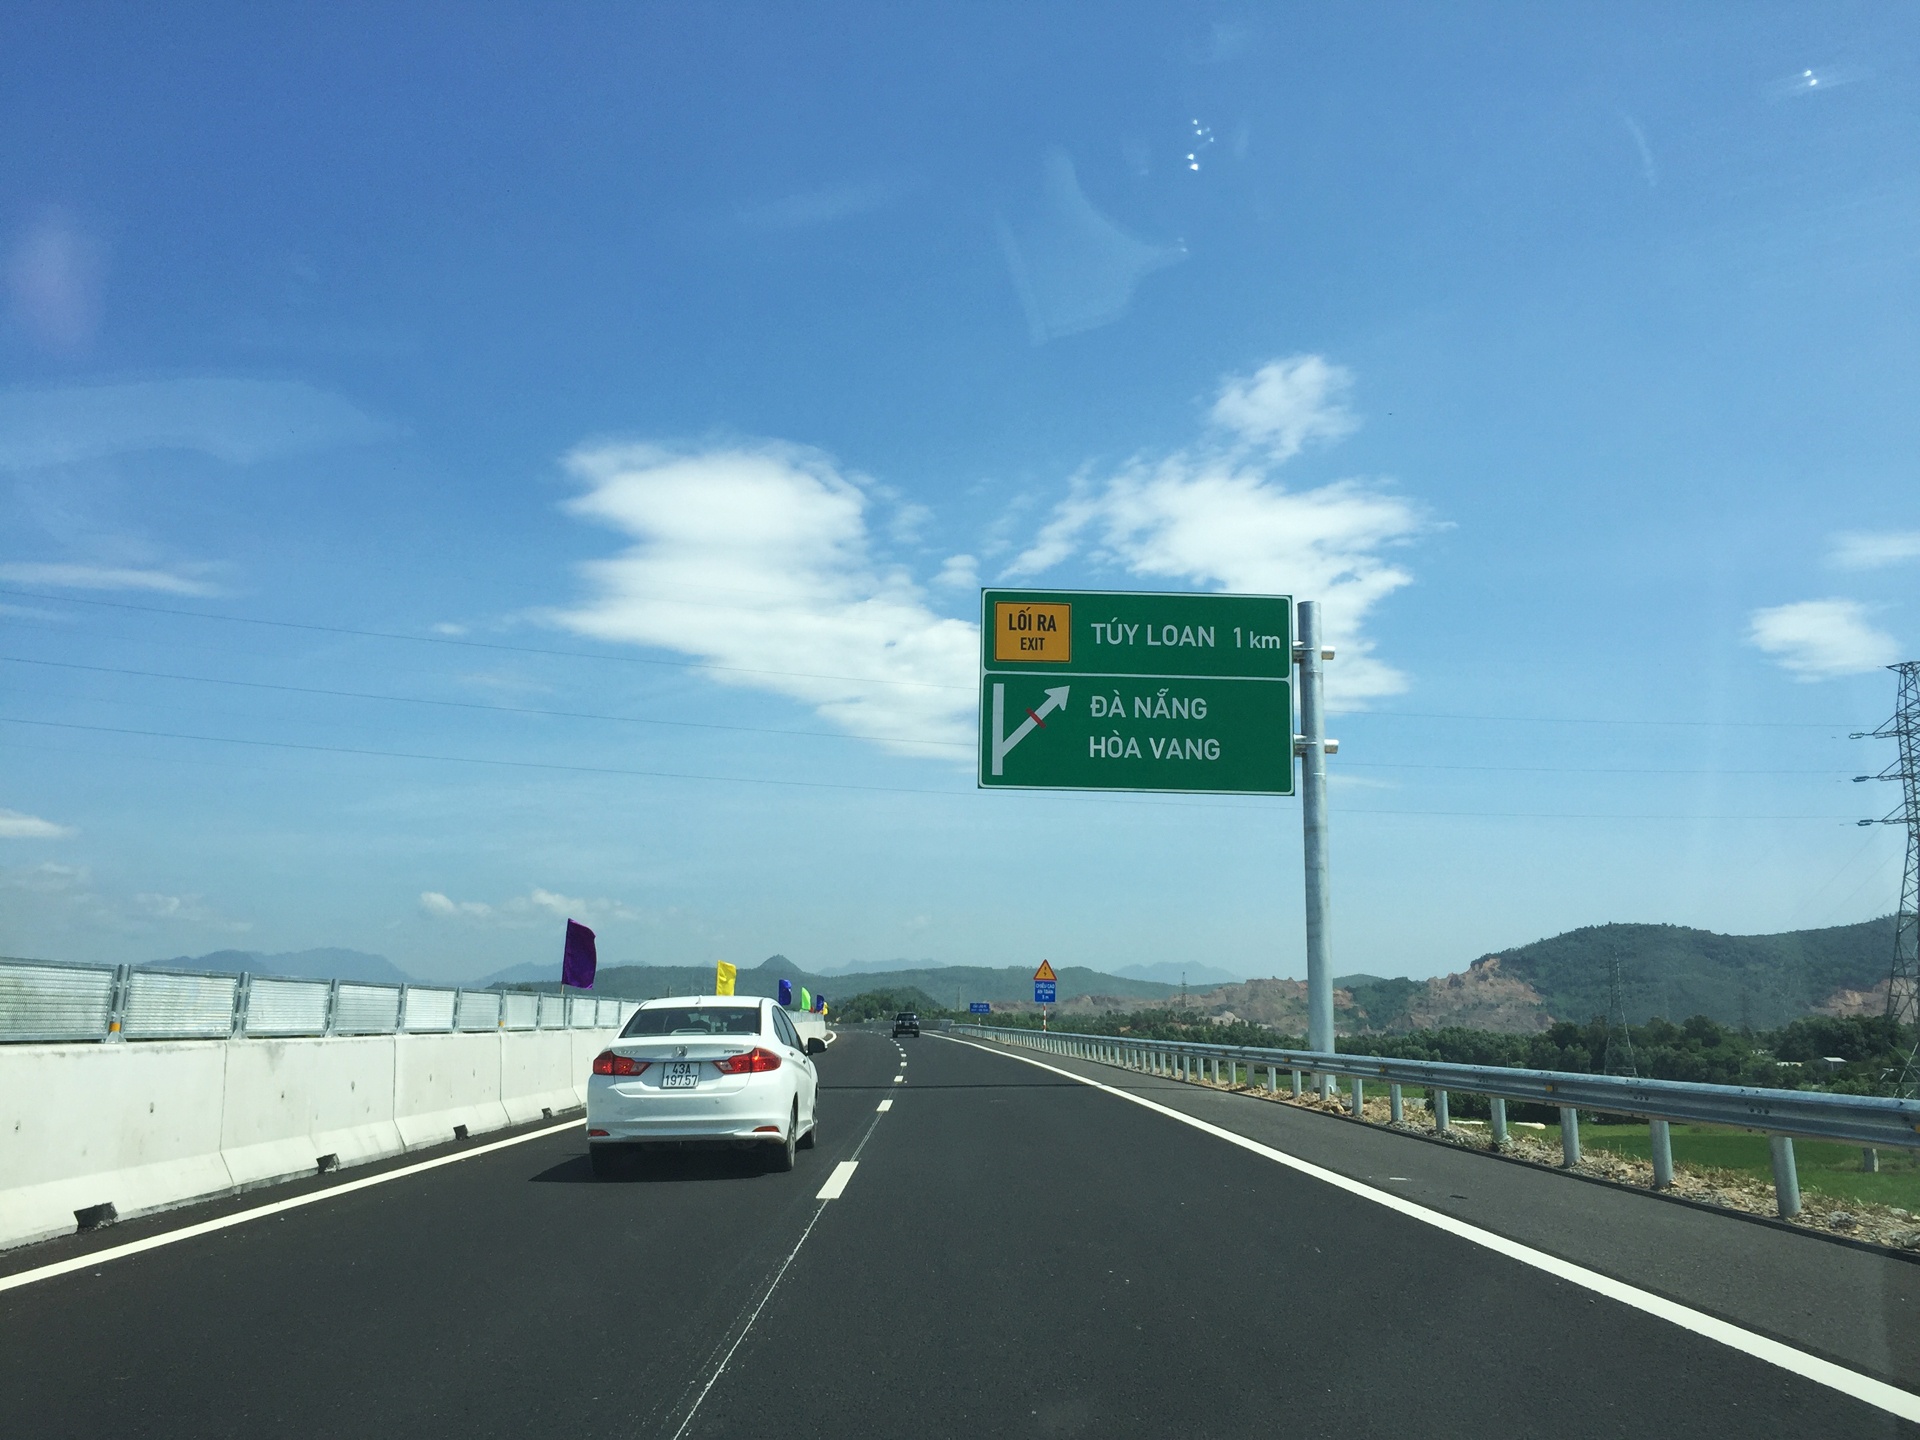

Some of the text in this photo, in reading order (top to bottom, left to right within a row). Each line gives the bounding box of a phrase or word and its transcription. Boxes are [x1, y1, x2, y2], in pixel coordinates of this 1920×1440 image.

[1008, 606, 1057, 632] LỐI RA
[1020, 636, 1045, 651] EXIT
[1091, 617, 1281, 650] TÚY LOAN 1 km
[1090, 688, 1207, 720] ĐÀ NẴNG
[1089, 729, 1221, 761] HÒA VANG
[665, 1074, 698, 1086] 197.57
[672, 1063, 691, 1074] 43A
